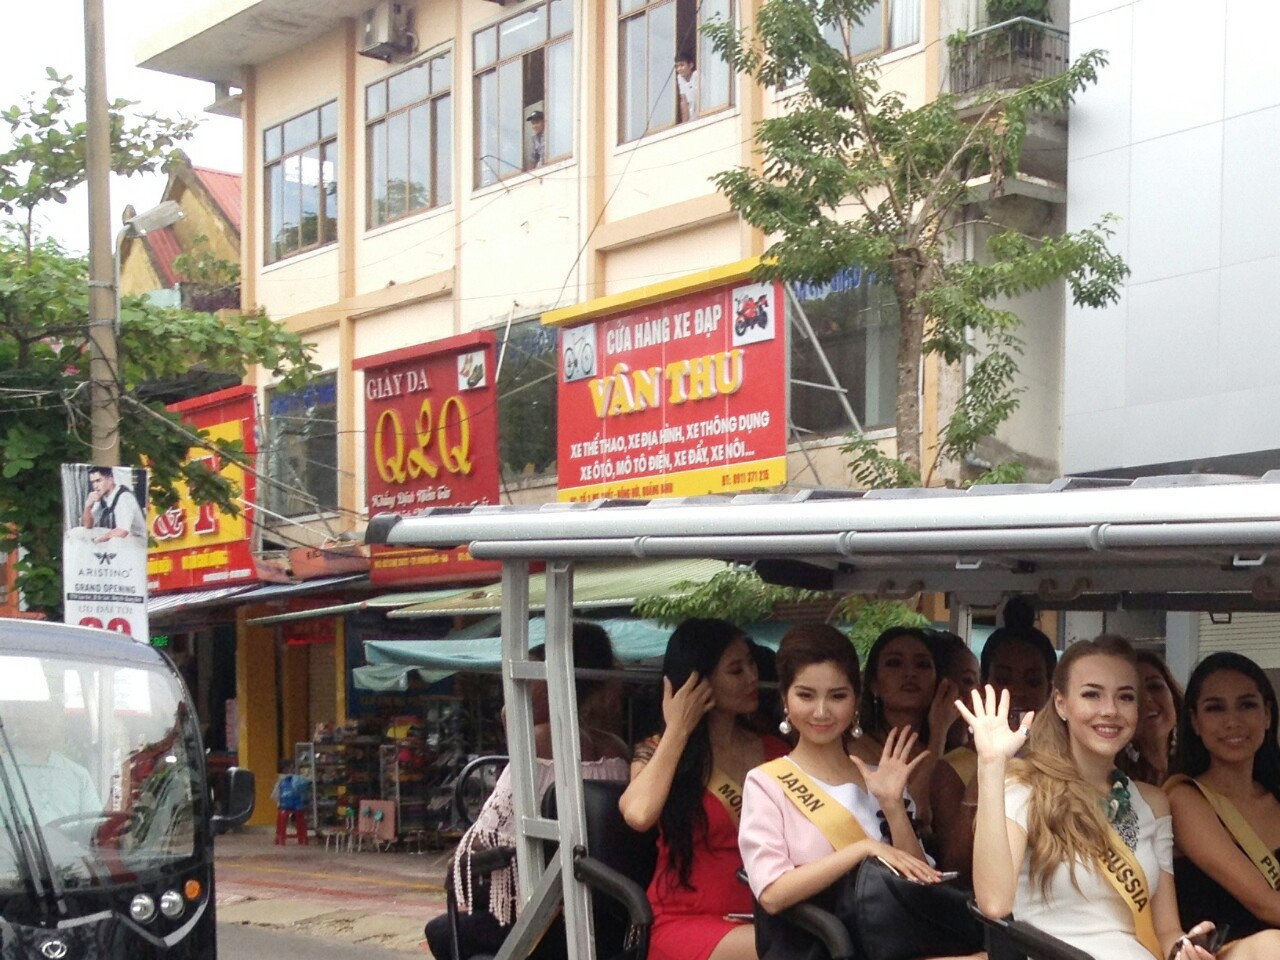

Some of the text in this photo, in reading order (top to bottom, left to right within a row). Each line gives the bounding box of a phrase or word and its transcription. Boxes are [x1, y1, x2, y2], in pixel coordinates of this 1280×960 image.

[606, 304, 722, 355] CỬA HÀNG XE ĐẠP
[366, 368, 429, 400] GIÀY DA
[588, 348, 745, 418] VÂN THU
[374, 396, 472, 484] Q&Q
[570, 410, 770, 459] XE THỂ THAO, XE ĐỊA HÌNH, XE THÔNG DỤNG
[580, 465, 592, 481] XE
[616, 455, 632, 475] MÔ
[633, 453, 647, 473] TÔ
[648, 450, 673, 474] ĐIỆN,
[674, 449, 687, 467] XE
[710, 444, 724, 462] XE
[725, 437, 755, 460] NÔI...
[74, 583, 136, 594] GRAND OPENING
[78, 567, 131, 579] ARISTINO
[776, 771, 825, 813] JAPAN
